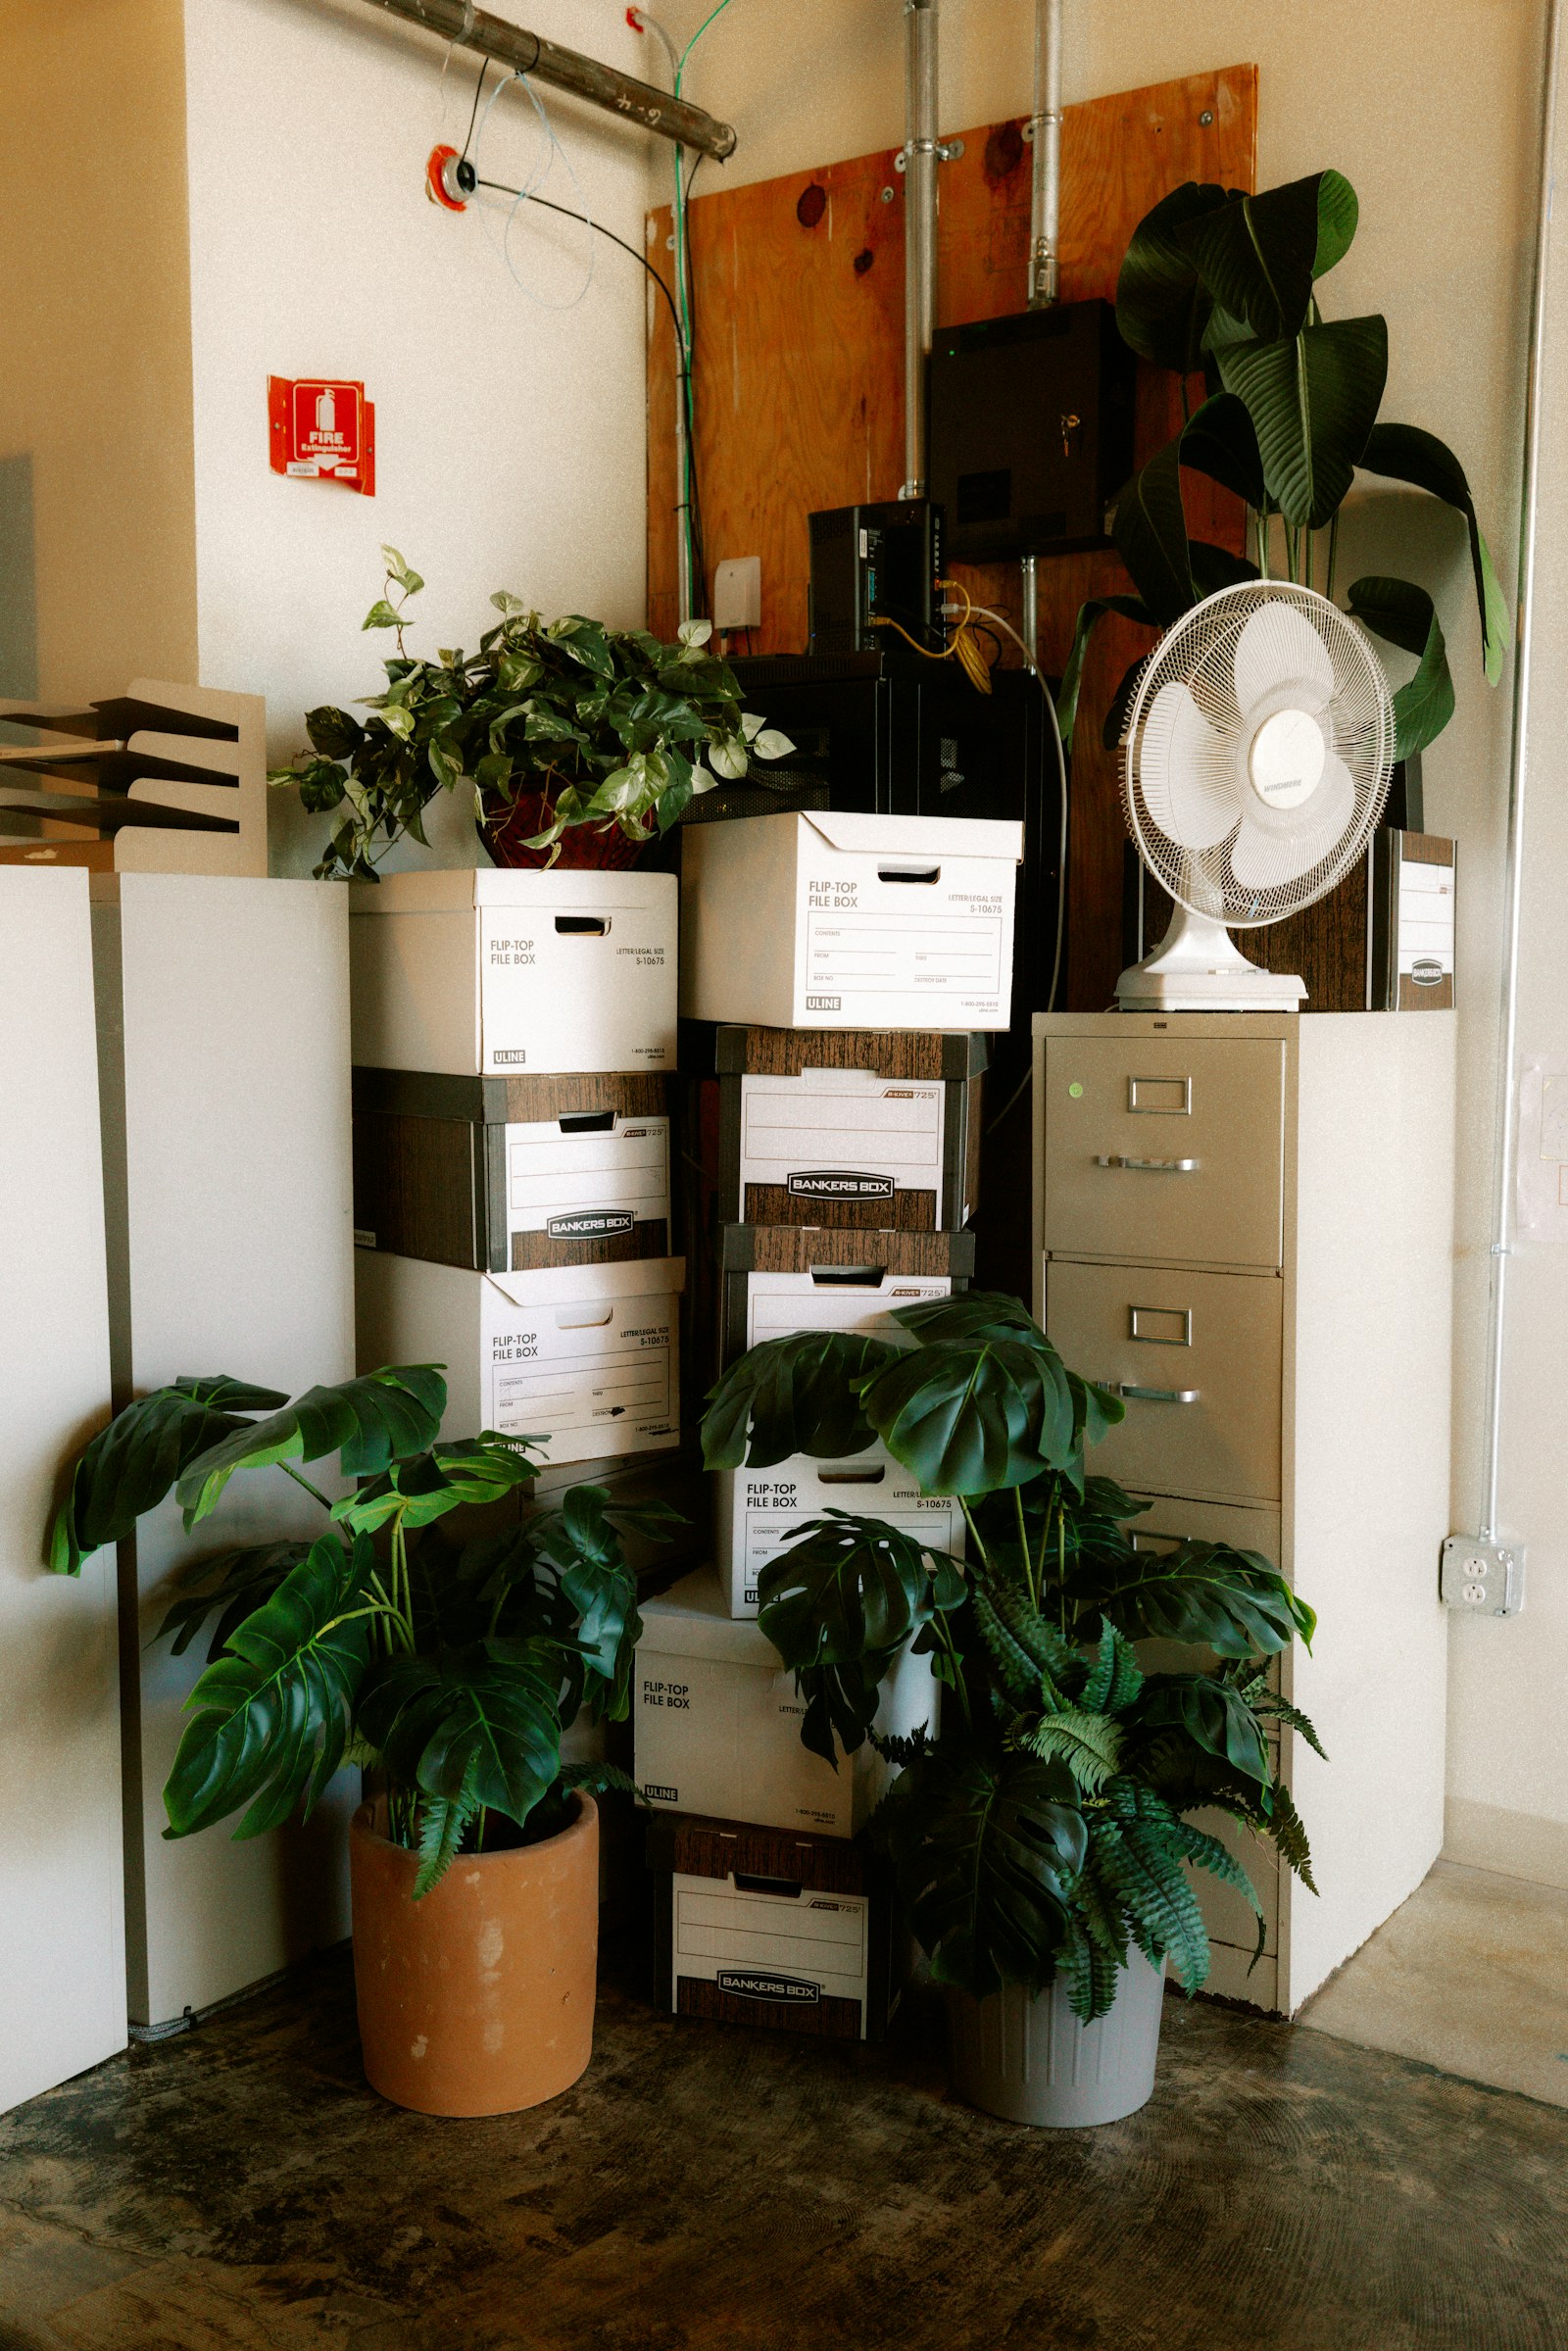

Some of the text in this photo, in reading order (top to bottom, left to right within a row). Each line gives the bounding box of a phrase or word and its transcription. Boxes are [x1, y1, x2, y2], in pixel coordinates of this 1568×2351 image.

[309, 431, 344, 444] FIRE
[301, 443, 351, 453] Extinguisher
[809, 881, 858, 894] FLIP-TOP
[808, 896, 858, 908] FILE BOX
[949, 894, 989, 903] LETTER/LEGAL
[970, 905, 1003, 913] S-10675
[490, 940, 534, 952] FLIP-TOP
[491, 954, 536, 965] FILE BOX
[636, 956, 664, 965] S-10675
[808, 998, 840, 1009] ULINE
[495, 1052, 524, 1063] ULINE
[793, 1179, 889, 1193] BANKERS BOX
[552, 1217, 630, 1233] BANKERS BOX
[620, 1328, 658, 1338] LETTER/LEGAL
[492, 1334, 537, 1347] FLIP-TOP
[640, 1336, 669, 1346] S-10675
[493, 1347, 538, 1360] FILE BOX
[747, 1484, 797, 1494] FLIP-TOP
[747, 1497, 797, 1507] FILE BOX
[644, 1681, 689, 1696] FLIP-TOP
[644, 1694, 690, 1709] FILE BOX
[646, 1787, 676, 1800] ULINE
[722, 1977, 815, 1997] BANKERS BOX
